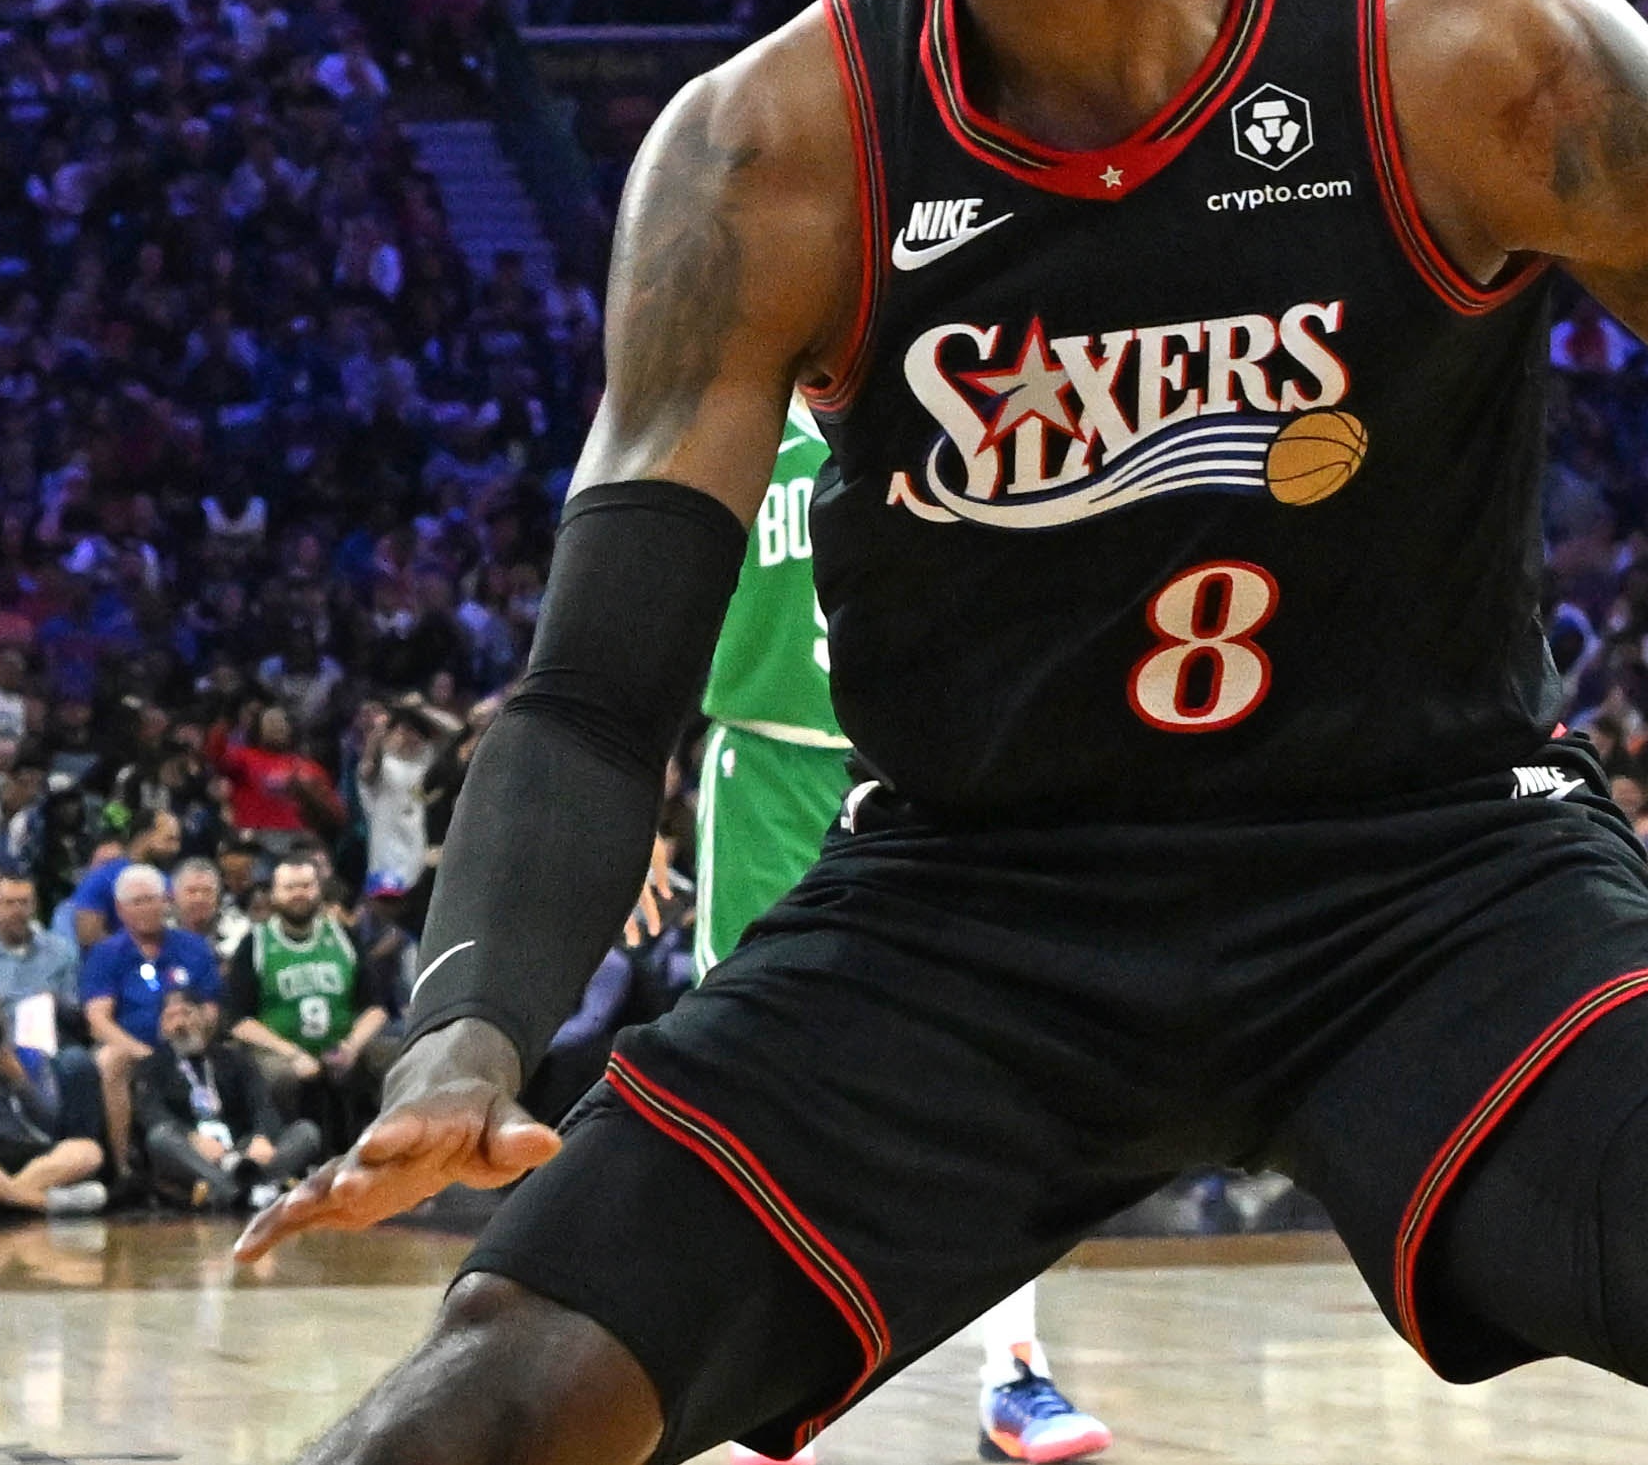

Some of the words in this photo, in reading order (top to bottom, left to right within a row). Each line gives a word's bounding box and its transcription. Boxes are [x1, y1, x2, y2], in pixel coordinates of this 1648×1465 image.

[1207, 177, 1352, 212] crypto.com
[905, 198, 983, 241] NIKE
[1127, 559, 1280, 733] 8
